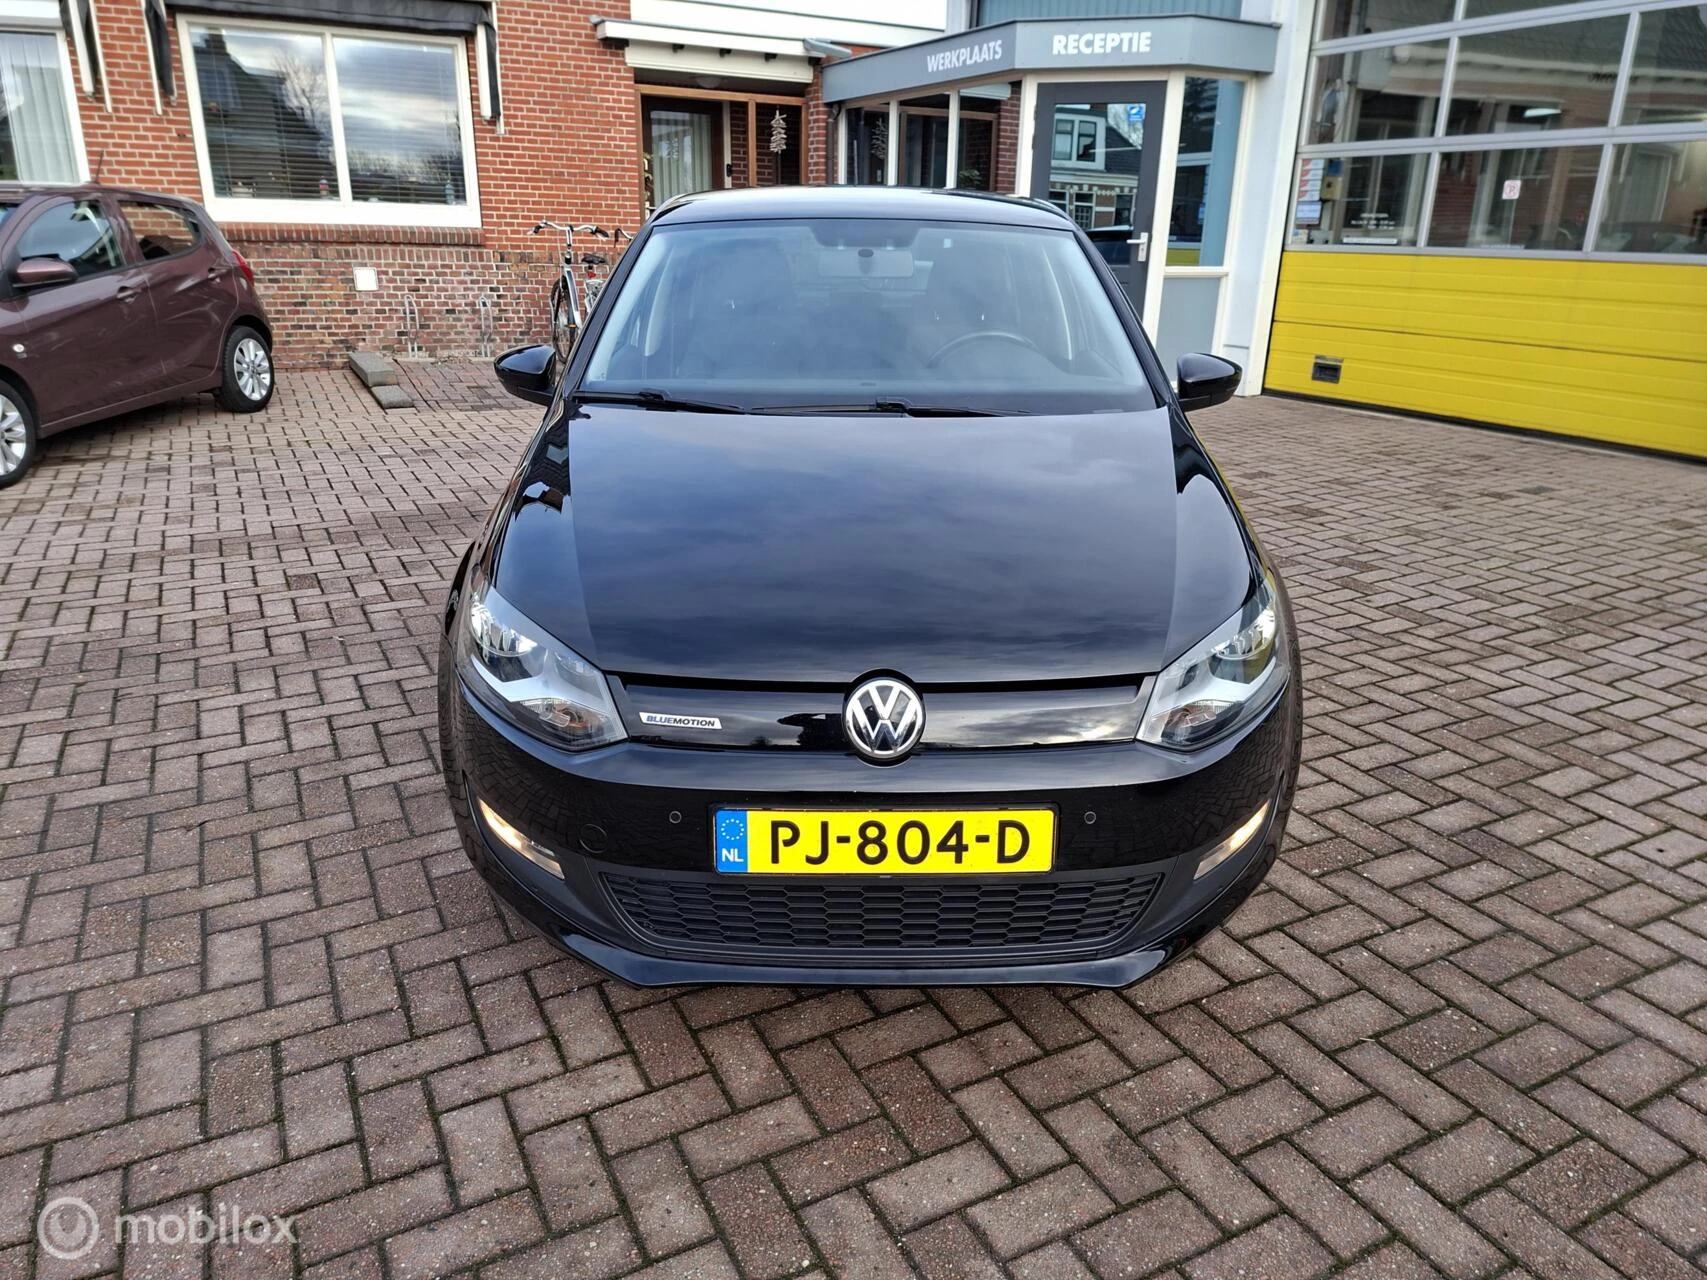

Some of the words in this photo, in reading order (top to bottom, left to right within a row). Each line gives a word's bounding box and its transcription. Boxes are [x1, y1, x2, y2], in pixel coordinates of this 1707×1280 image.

[927, 40, 1002, 73] WERKPLAATS
[1053, 32, 1151, 55] RECEPTIE
[646, 715, 716, 727] BLUEMOTION
[846, 680, 923, 757] VW
[721, 848, 744, 863] NL
[771, 820, 1030, 865] PJ-804-D
